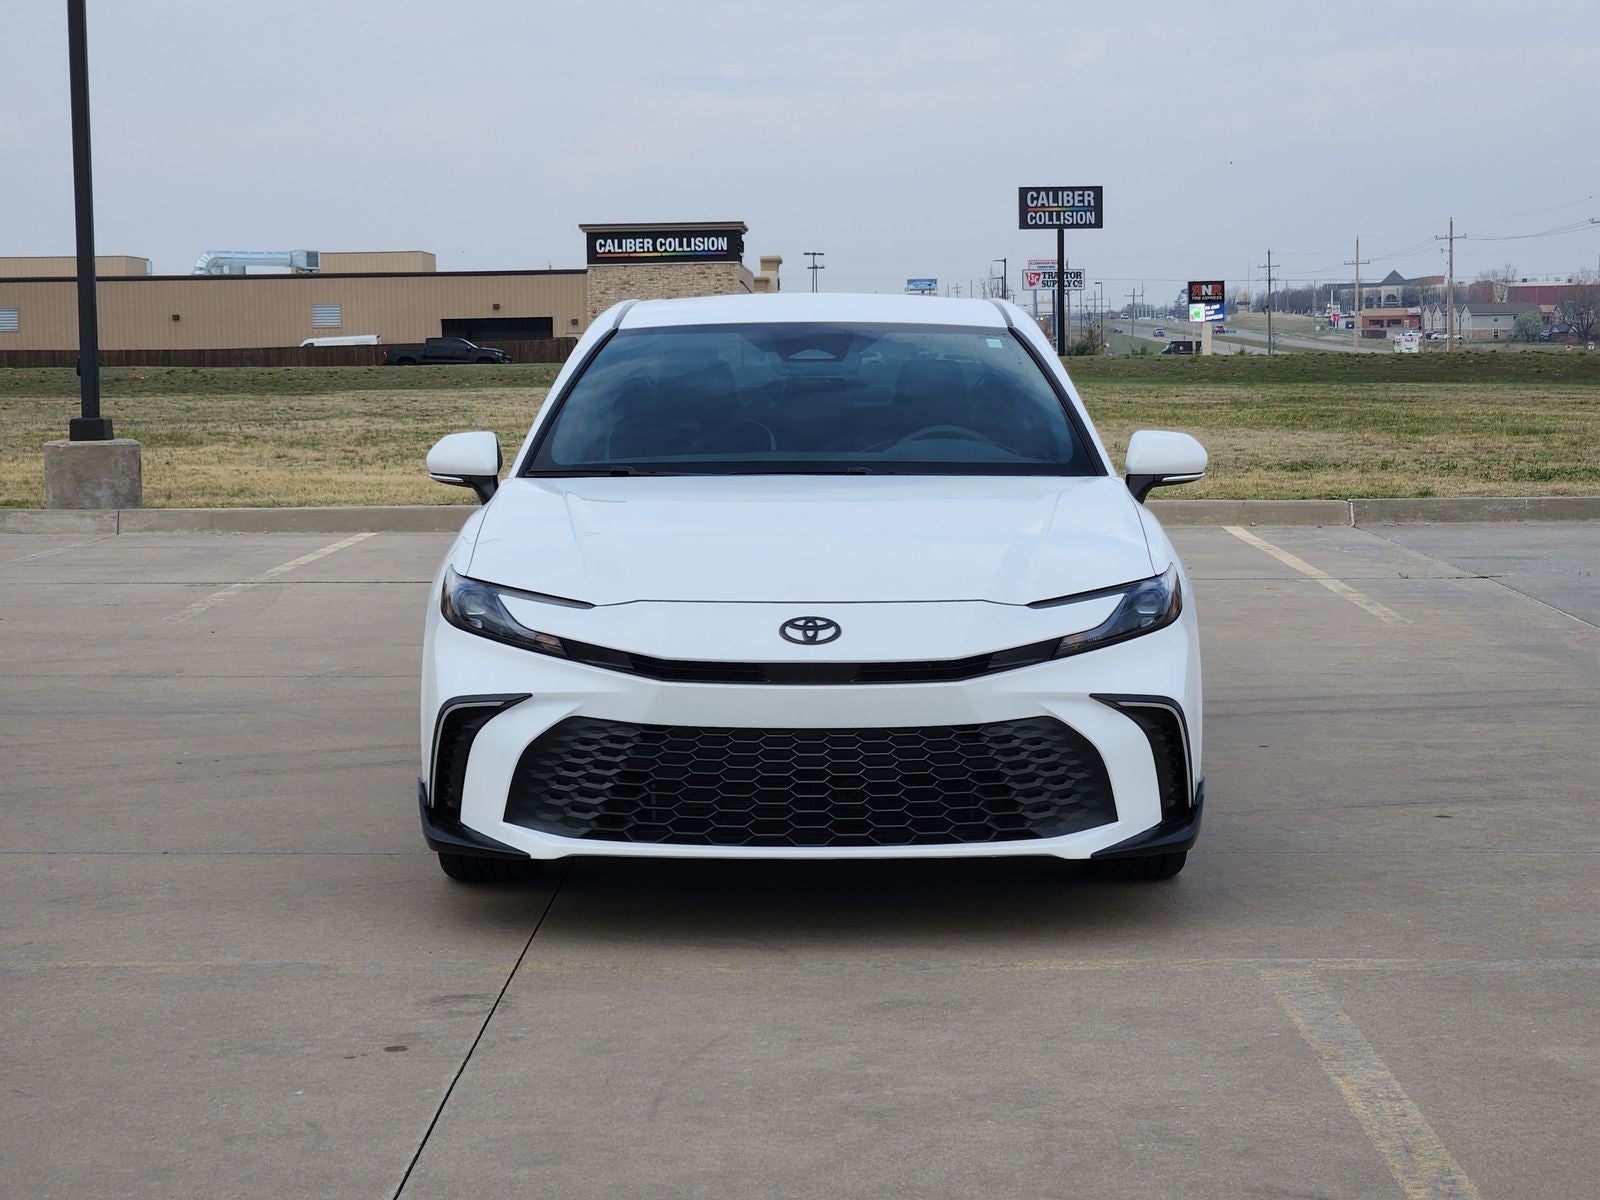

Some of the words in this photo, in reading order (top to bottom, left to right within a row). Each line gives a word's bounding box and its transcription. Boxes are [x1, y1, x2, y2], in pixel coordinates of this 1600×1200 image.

[1026, 190, 1095, 207] CALIBER
[1027, 211, 1096, 225] COLLISION
[595, 238, 653, 253] CALIBER
[656, 236, 728, 252] COLLISION
[1027, 272, 1040, 284] TSC
[1041, 271, 1082, 280] TRATOR
[1041, 279, 1072, 288] SUPY
